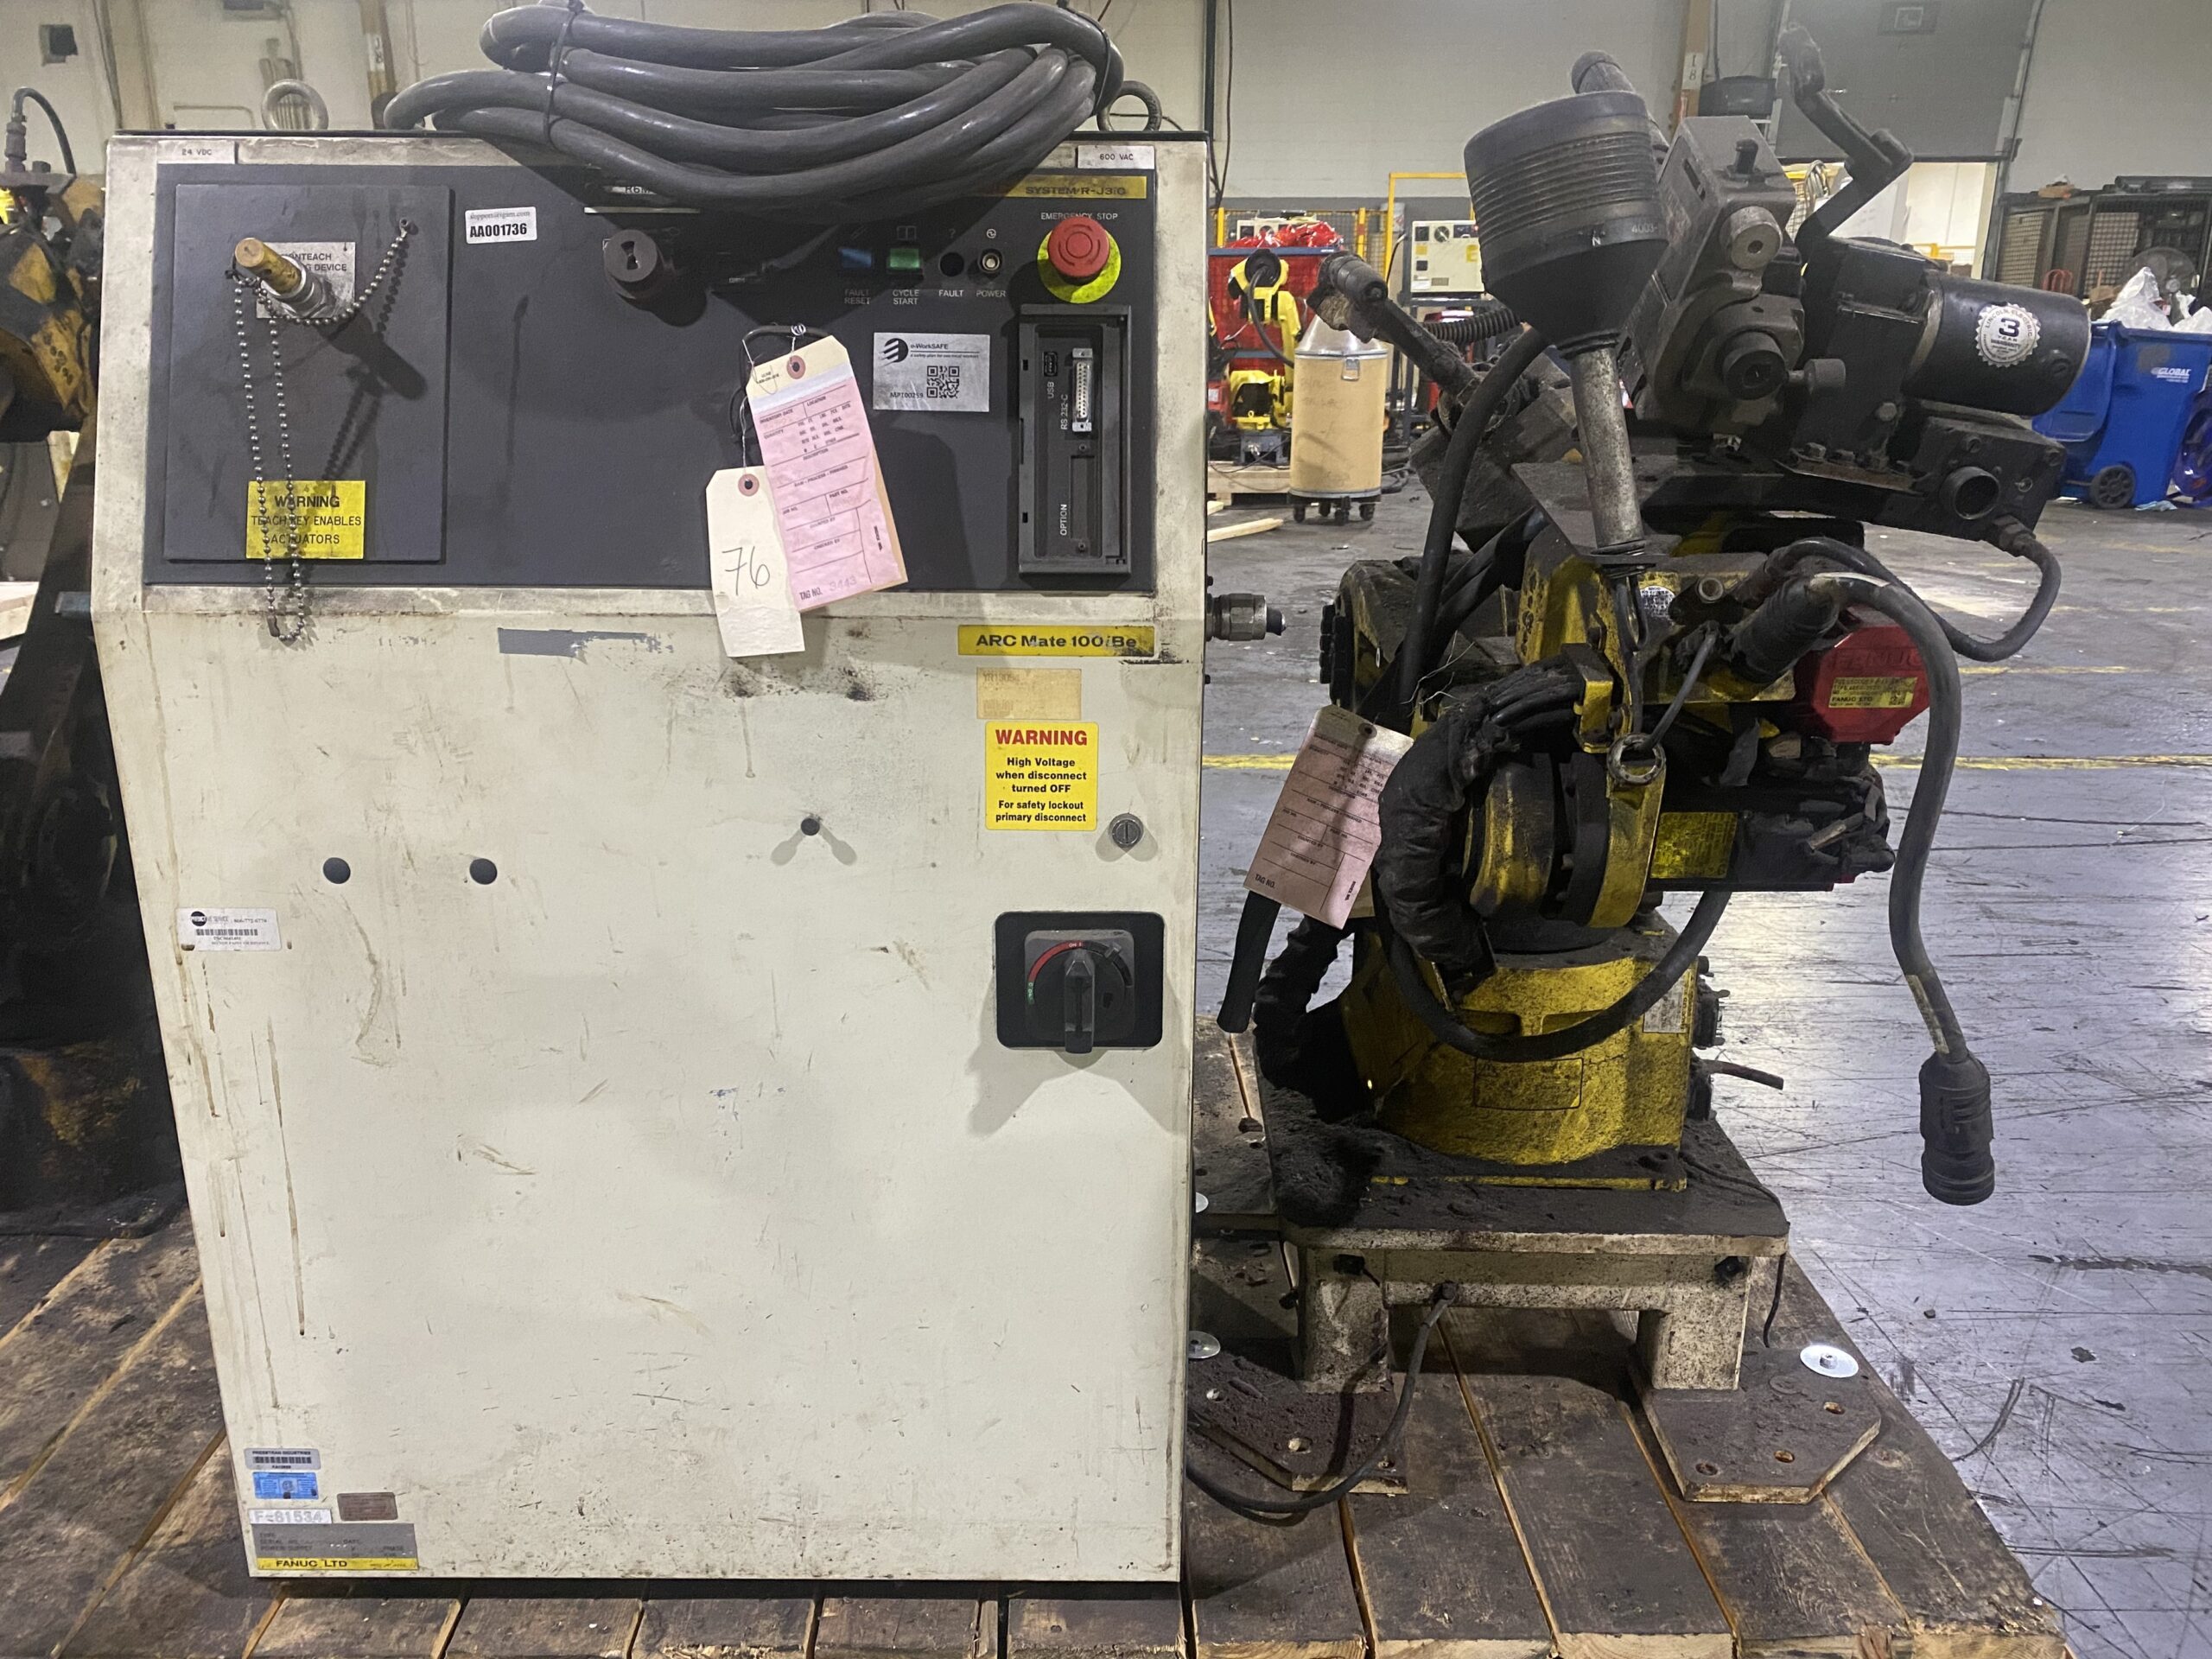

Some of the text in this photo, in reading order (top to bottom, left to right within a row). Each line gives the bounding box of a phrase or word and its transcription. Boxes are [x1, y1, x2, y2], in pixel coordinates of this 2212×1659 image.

[1026, 187, 1077, 195] SYSTEM
[470, 223, 527, 238] AA001736
[1999, 318, 2020, 337] 3
[1060, 421, 1068, 430] RS
[314, 516, 361, 525] ENABLES
[721, 546, 771, 596] 76
[798, 589, 811, 601] TAG
[811, 587, 823, 596] NO.
[976, 635, 1137, 648] ARC Mate 100iBe
[995, 729, 1087, 746] WARNING
[1007, 757, 1076, 768] High Voltage
[995, 771, 1087, 780] when disconnect
[1012, 784, 1046, 792] turned
[998, 800, 1084, 810] For safety lockout
[995, 812, 1087, 823] primary disconnect
[1255, 873, 1276, 889] TAG NO.
